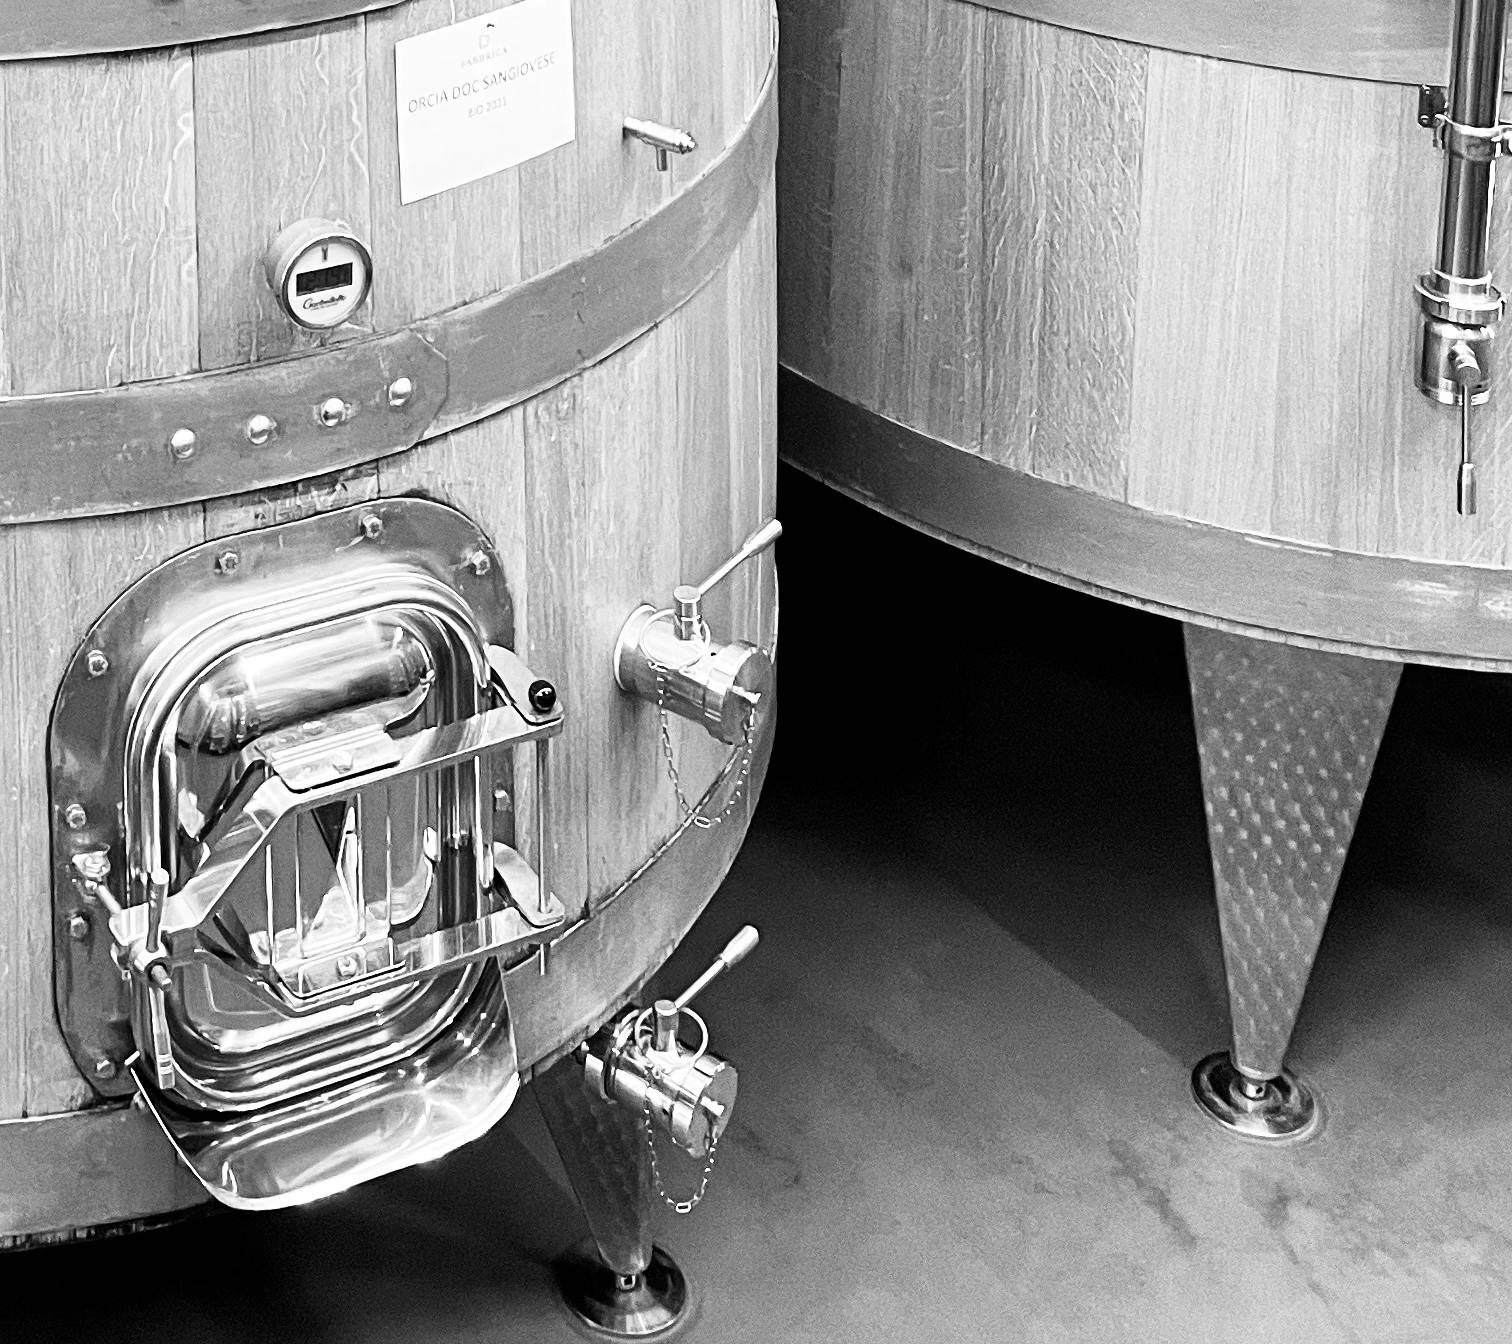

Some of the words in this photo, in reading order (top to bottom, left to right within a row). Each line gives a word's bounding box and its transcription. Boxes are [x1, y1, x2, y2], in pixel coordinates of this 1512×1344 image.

[408, 89, 449, 113] ORCIA
[451, 79, 480, 101] DOC
[482, 50, 557, 91] SANGIOVESE
